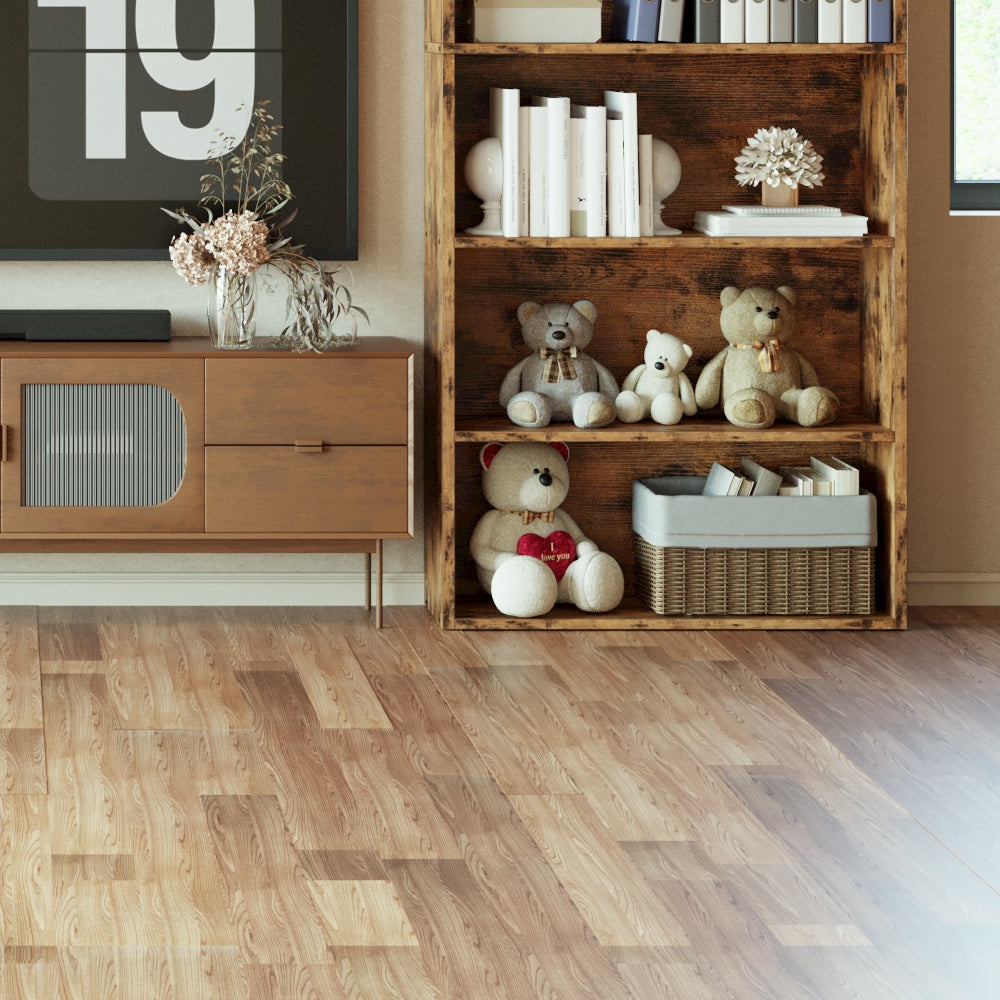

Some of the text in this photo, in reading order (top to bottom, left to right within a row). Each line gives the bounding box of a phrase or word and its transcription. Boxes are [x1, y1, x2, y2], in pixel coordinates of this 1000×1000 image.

[550, 542, 554, 552] I
[541, 553, 570, 563] love you
